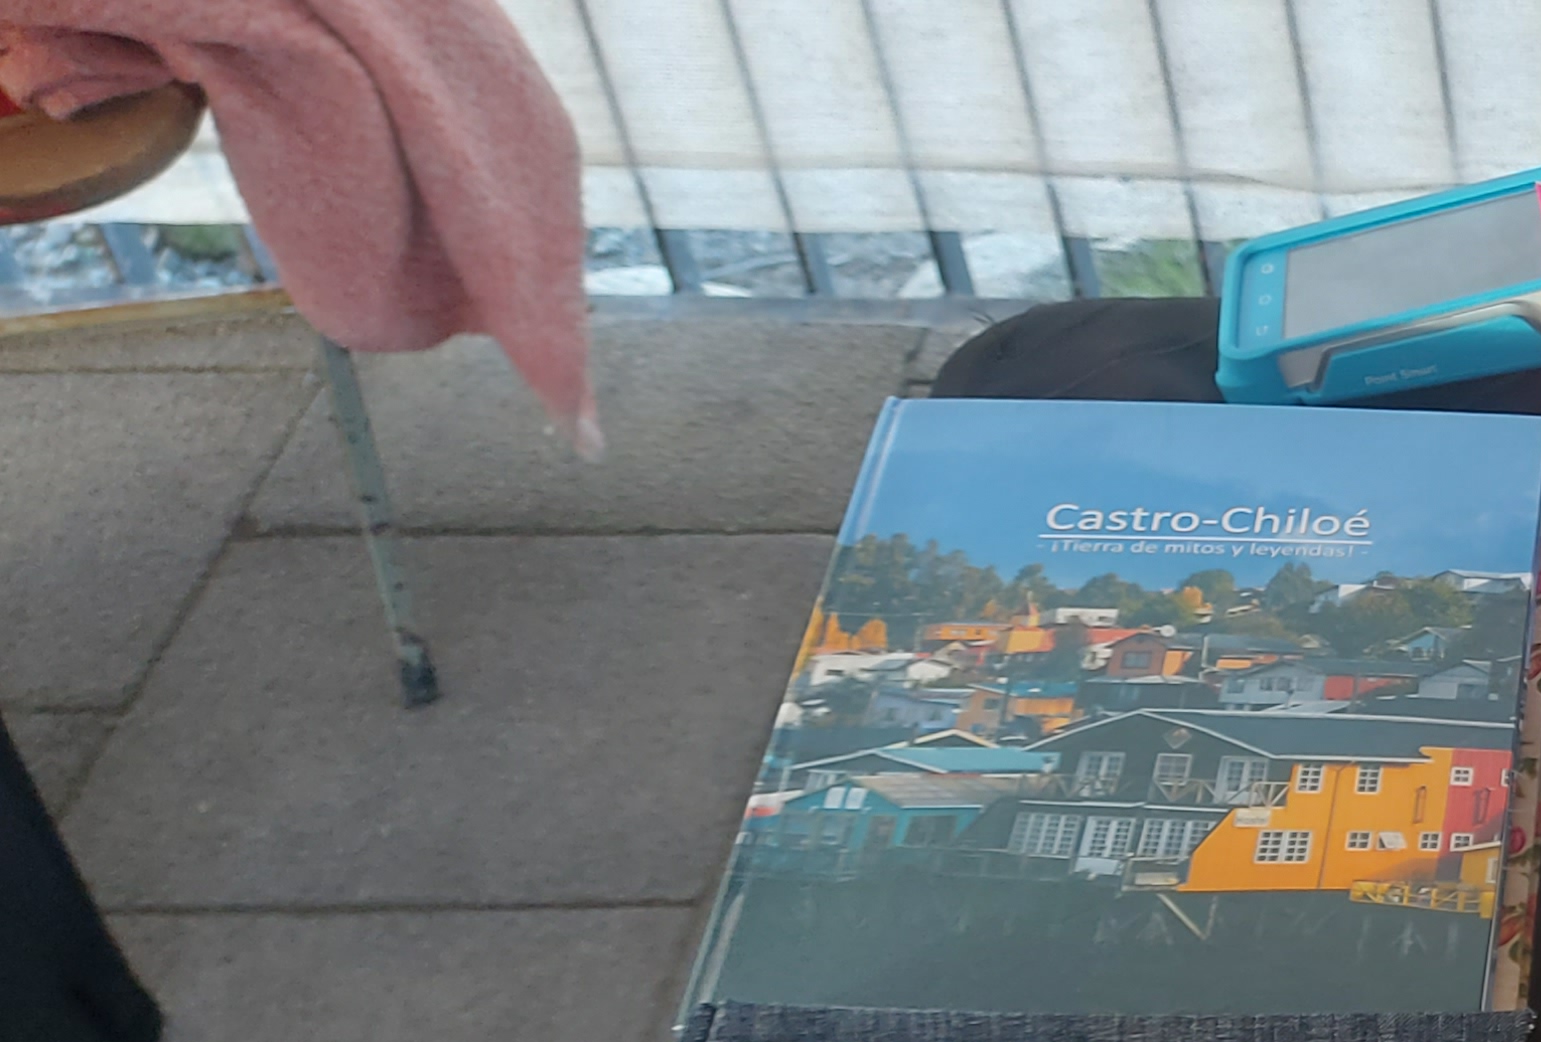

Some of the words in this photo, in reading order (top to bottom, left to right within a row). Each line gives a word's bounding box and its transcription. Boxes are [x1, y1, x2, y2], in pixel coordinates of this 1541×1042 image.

[1045, 502, 1372, 537] Castro-Chiloé
[1130, 540, 1159, 555] de
[1164, 542, 1226, 556] mitos
[1231, 545, 1244, 558] y
[1250, 543, 1355, 559] leyendas!
